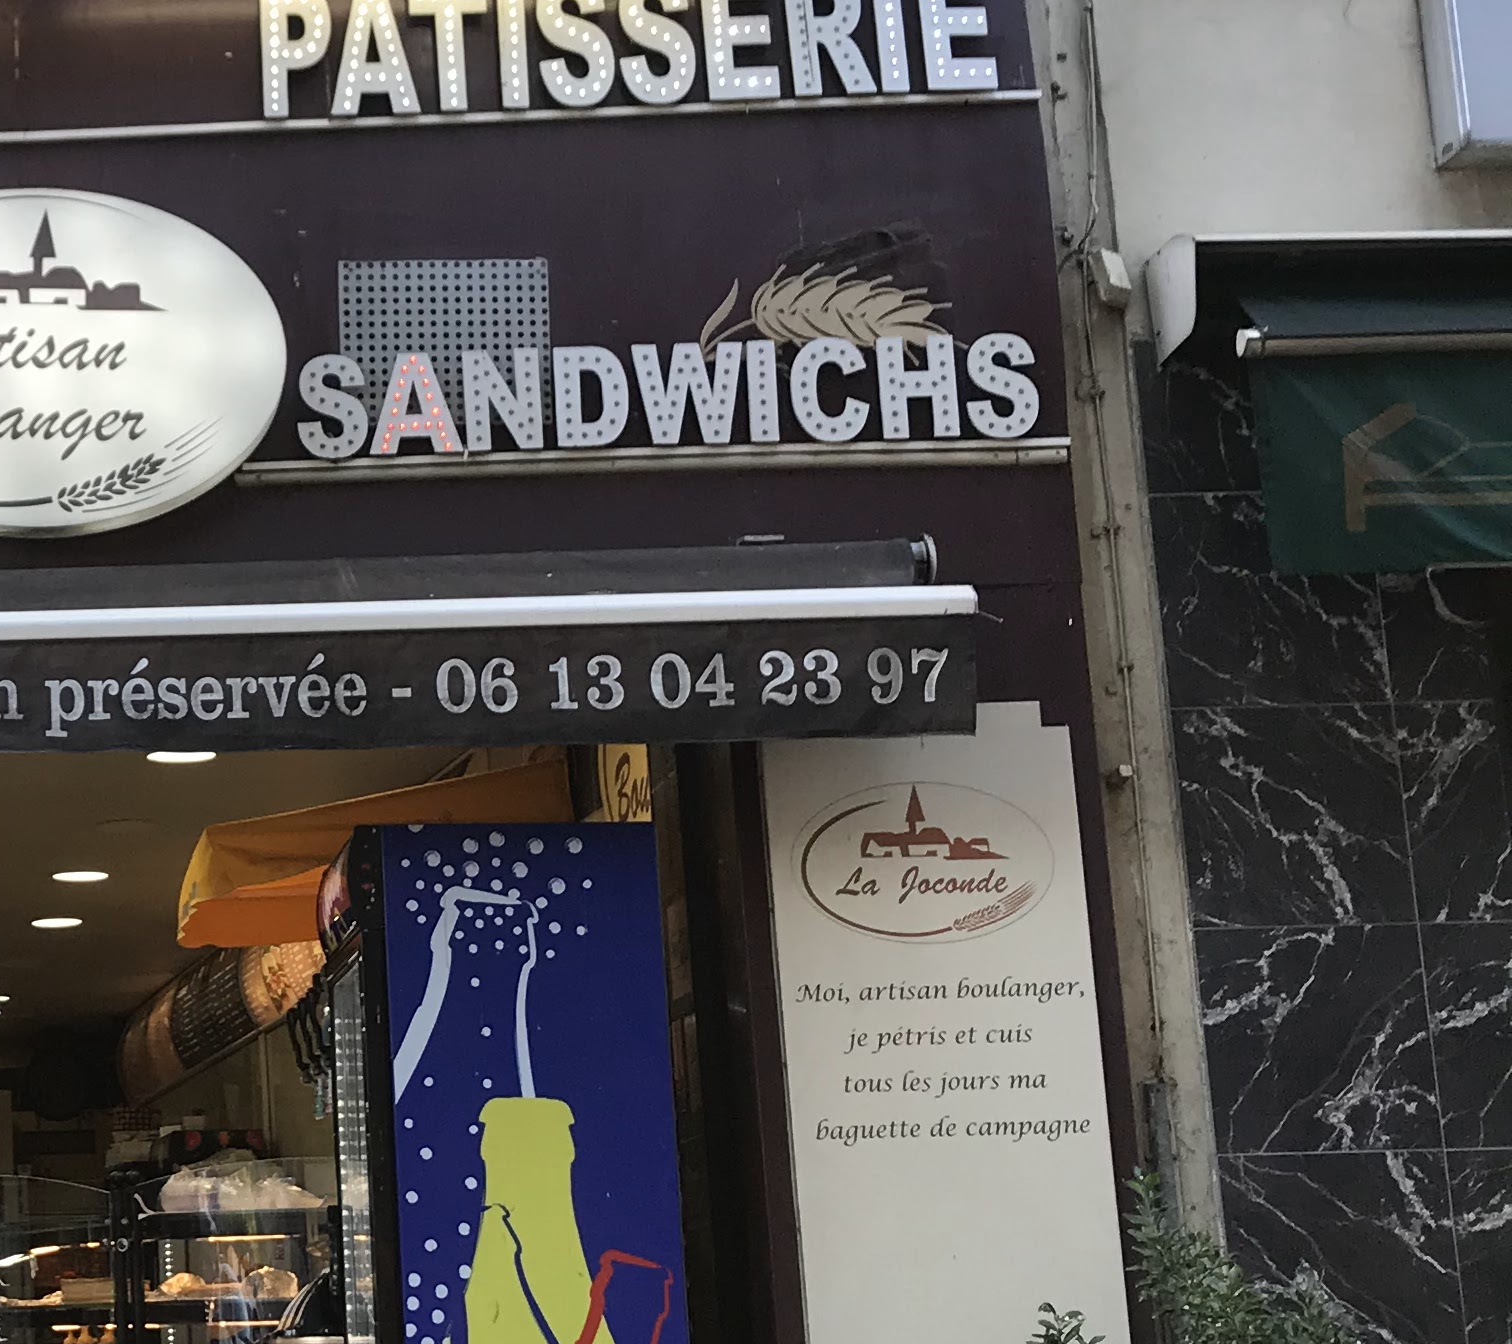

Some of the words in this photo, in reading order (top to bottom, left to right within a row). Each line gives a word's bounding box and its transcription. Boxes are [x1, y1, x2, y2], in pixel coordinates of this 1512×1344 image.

[297, 332, 1041, 459] SANDWICHS
[44, 652, 368, 738] préservée
[435, 656, 519, 715] 06
[548, 654, 626, 711] 13
[649, 652, 736, 710] 04
[760, 648, 842, 706] 23
[867, 646, 949, 705] 97
[835, 866, 880, 896] La
[898, 865, 1008, 904] Joconde
[795, 982, 851, 1004] Moi,
[858, 980, 947, 1001] artisan
[956, 975, 1086, 1004] boulanger,
[843, 1026, 868, 1055] je
[872, 1024, 947, 1054] pétris
[955, 1027, 977, 1046] et
[985, 1023, 1033, 1044] cuis
[843, 1074, 893, 1094] tous
[901, 1070, 932, 1093] les
[935, 1072, 1000, 1098] jours
[1007, 1072, 1048, 1090] ma
[815, 1117, 921, 1146] baguette
[929, 1115, 957, 1138] de
[965, 1115, 1091, 1142] campagne
